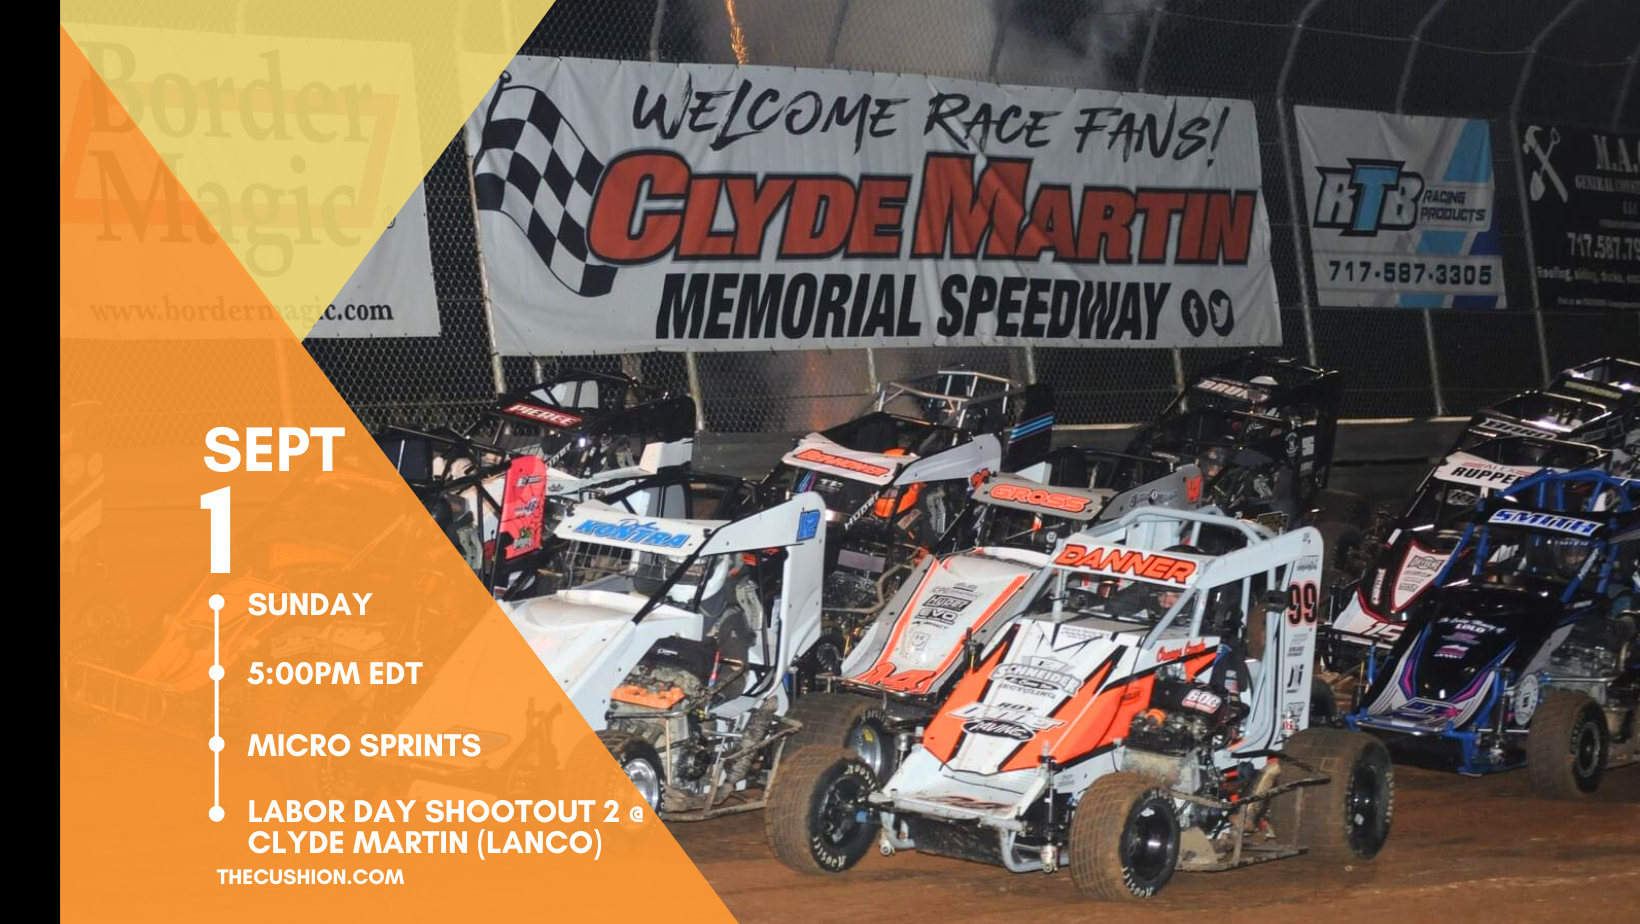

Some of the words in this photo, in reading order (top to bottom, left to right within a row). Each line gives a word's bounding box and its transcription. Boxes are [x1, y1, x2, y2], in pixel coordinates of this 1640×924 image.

[632, 76, 908, 156] WELCOME
[923, 85, 1063, 153] RACE
[1073, 100, 1231, 169] FANS!
[584, 146, 914, 266] CLYDE
[911, 151, 1258, 267] MARTIN
[1314, 157, 1425, 237] RTB
[1423, 190, 1467, 205] RACING
[1420, 206, 1486, 223] PRODUCTS
[89, 295, 394, 329] www.bordermagic.com
[655, 272, 921, 340] MEMORIAL
[937, 279, 1171, 341] SPEEDWAY
[509, 404, 576, 427] PIERCE
[990, 484, 1092, 513] GROSS
[573, 519, 691, 548] KONTRA
[1494, 511, 1597, 534] SMITH
[1053, 544, 1197, 585] DANNER
[918, 608, 958, 621] EVO
[1288, 580, 1318, 626] 99
[1362, 622, 1406, 643] 15
[1454, 623, 1487, 634] LOLO
[856, 662, 936, 694] 14
[989, 662, 1084, 698] SCHNEIDER
[996, 702, 1038, 712] ROY
[970, 721, 1028, 738] PAVING
